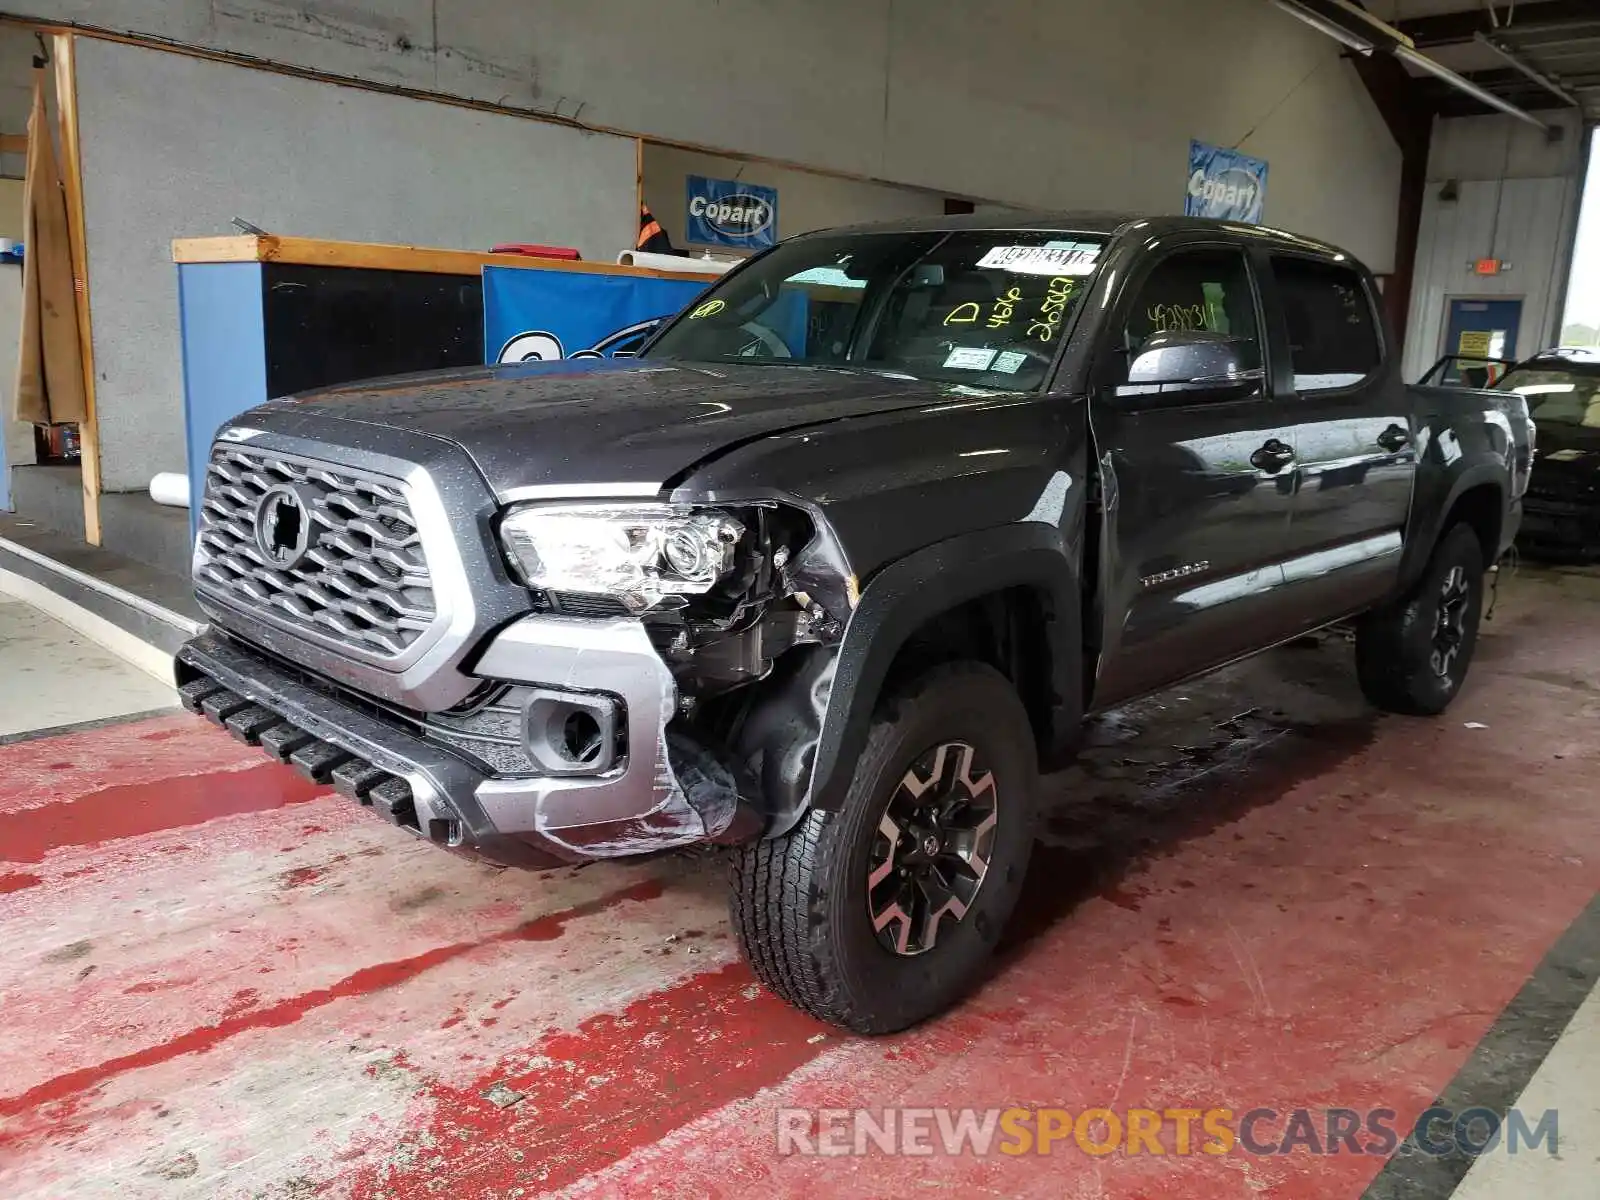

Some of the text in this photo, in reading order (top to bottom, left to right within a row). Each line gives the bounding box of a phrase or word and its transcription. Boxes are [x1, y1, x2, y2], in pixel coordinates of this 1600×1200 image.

[1188, 168, 1255, 209] Copart
[689, 196, 763, 226] Copart
[943, 302, 980, 327] D
[1140, 560, 1210, 587] TACOMA
